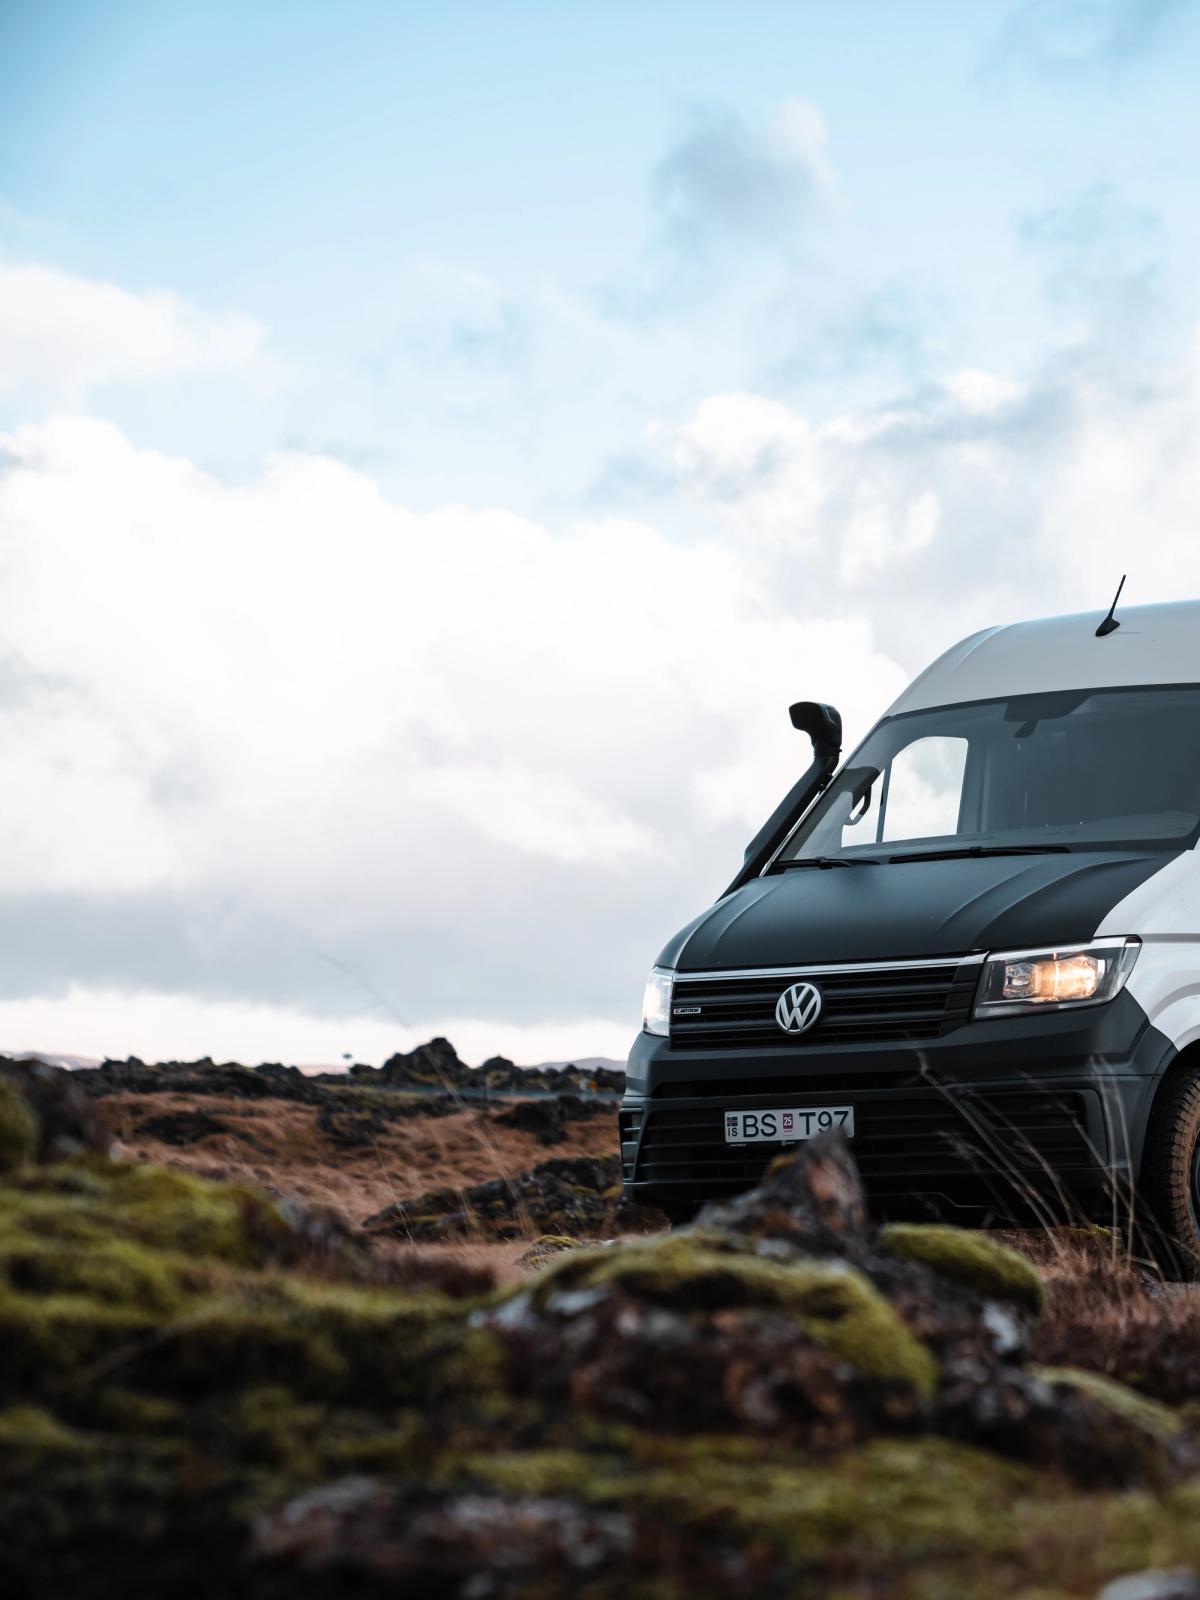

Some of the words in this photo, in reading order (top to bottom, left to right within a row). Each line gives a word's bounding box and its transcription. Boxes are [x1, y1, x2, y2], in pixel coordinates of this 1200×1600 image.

[728, 1127, 738, 1137] IS
[743, 1113, 777, 1138] BS
[799, 1110, 849, 1135] T97
